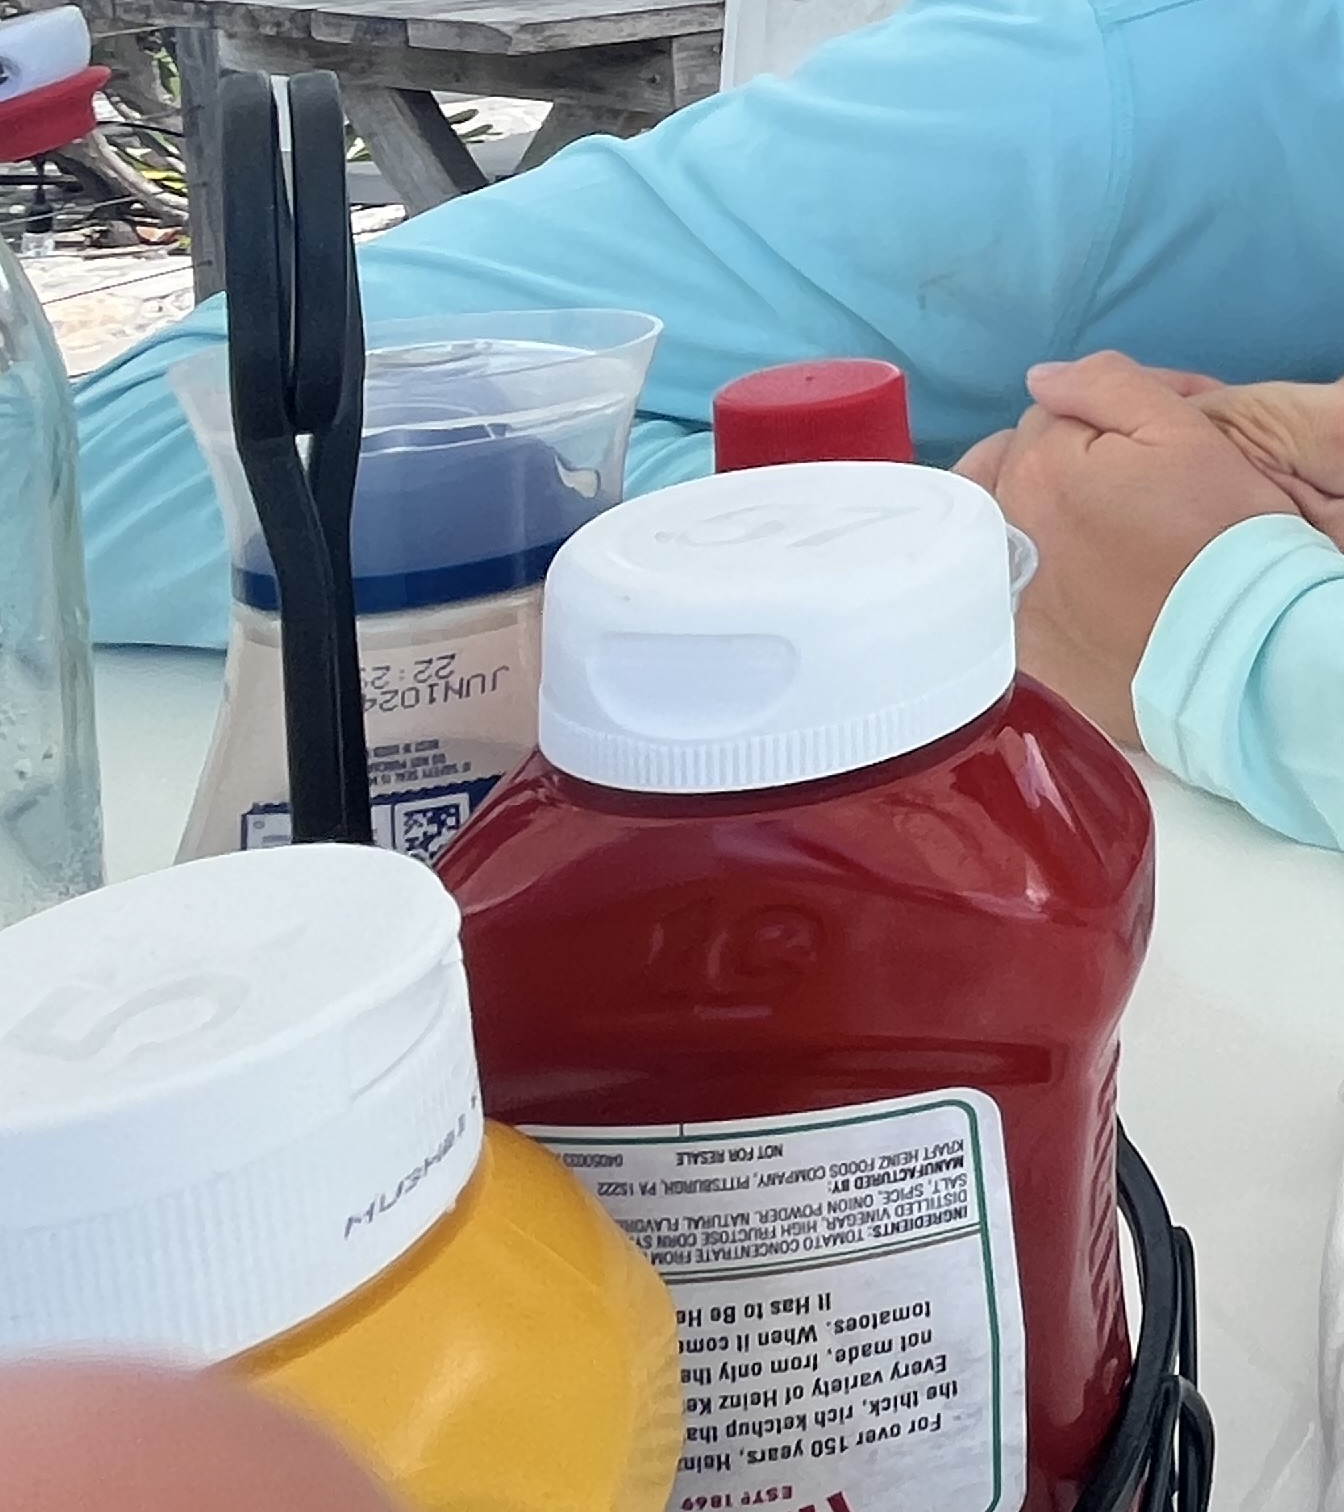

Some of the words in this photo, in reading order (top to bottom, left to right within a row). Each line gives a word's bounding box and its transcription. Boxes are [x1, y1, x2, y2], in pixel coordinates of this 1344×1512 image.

[676, 1149, 725, 1166] RESALE
[728, 1147, 754, 1162] FOR
[757, 1143, 783, 1160] NOT
[878, 1149, 919, 1169] HEINZ
[923, 1139, 964, 1161] KRAFT
[753, 1165, 826, 1188] COMPANY,
[829, 1157, 876, 1178] FOODS
[855, 1155, 964, 1189] MANUFACTURED
[639, 1181, 656, 1196] PA
[827, 1178, 850, 1193] BY:
[928, 1173, 967, 1194] SALT,
[827, 1194, 874, 1214] ONION
[894, 1189, 967, 1217] DISTILLED
[780, 1220, 818, 1237] HIGH
[867, 1205, 968, 1238] INGREDIENTS:
[629, 1235, 653, 1249] SY
[657, 1233, 697, 1248] CORN
[701, 1225, 776, 1246] FRUCTOSE
[803, 1229, 864, 1251] TOMATO
[650, 1250, 691, 1265] FROM
[695, 1238, 799, 1264] CONCENTRATE
[744, 1302, 764, 1319] to
[770, 1296, 810, 1316] Has
[818, 1292, 831, 1311] It
[710, 1306, 736, 1324] Be
[826, 1301, 931, 1335] tomatoes.
[736, 1333, 749, 1352] it
[758, 1324, 817, 1346] When
[900, 1329, 932, 1352] not
[827, 1338, 893, 1365] made,
[718, 1361, 762, 1383] only
[770, 1353, 818, 1373] from
[890, 1354, 947, 1381] Every
[681, 1367, 711, 1386] the
[811, 1371, 884, 1398] variety
[719, 1389, 777, 1411] Heinz
[785, 1385, 804, 1405] of
[926, 1380, 958, 1400] the
[683, 1397, 712, 1415] Ke
[862, 1390, 918, 1417] thick,
[726, 1413, 807, 1438] ketchup
[814, 1404, 853, 1428] rich
[907, 1412, 942, 1435] For
[683, 1425, 718, 1443] tha
[856, 1423, 901, 1446] over
[739, 1439, 804, 1465] years,
[811, 1436, 849, 1458] 150
[681, 1494, 733, 1511] 1869
